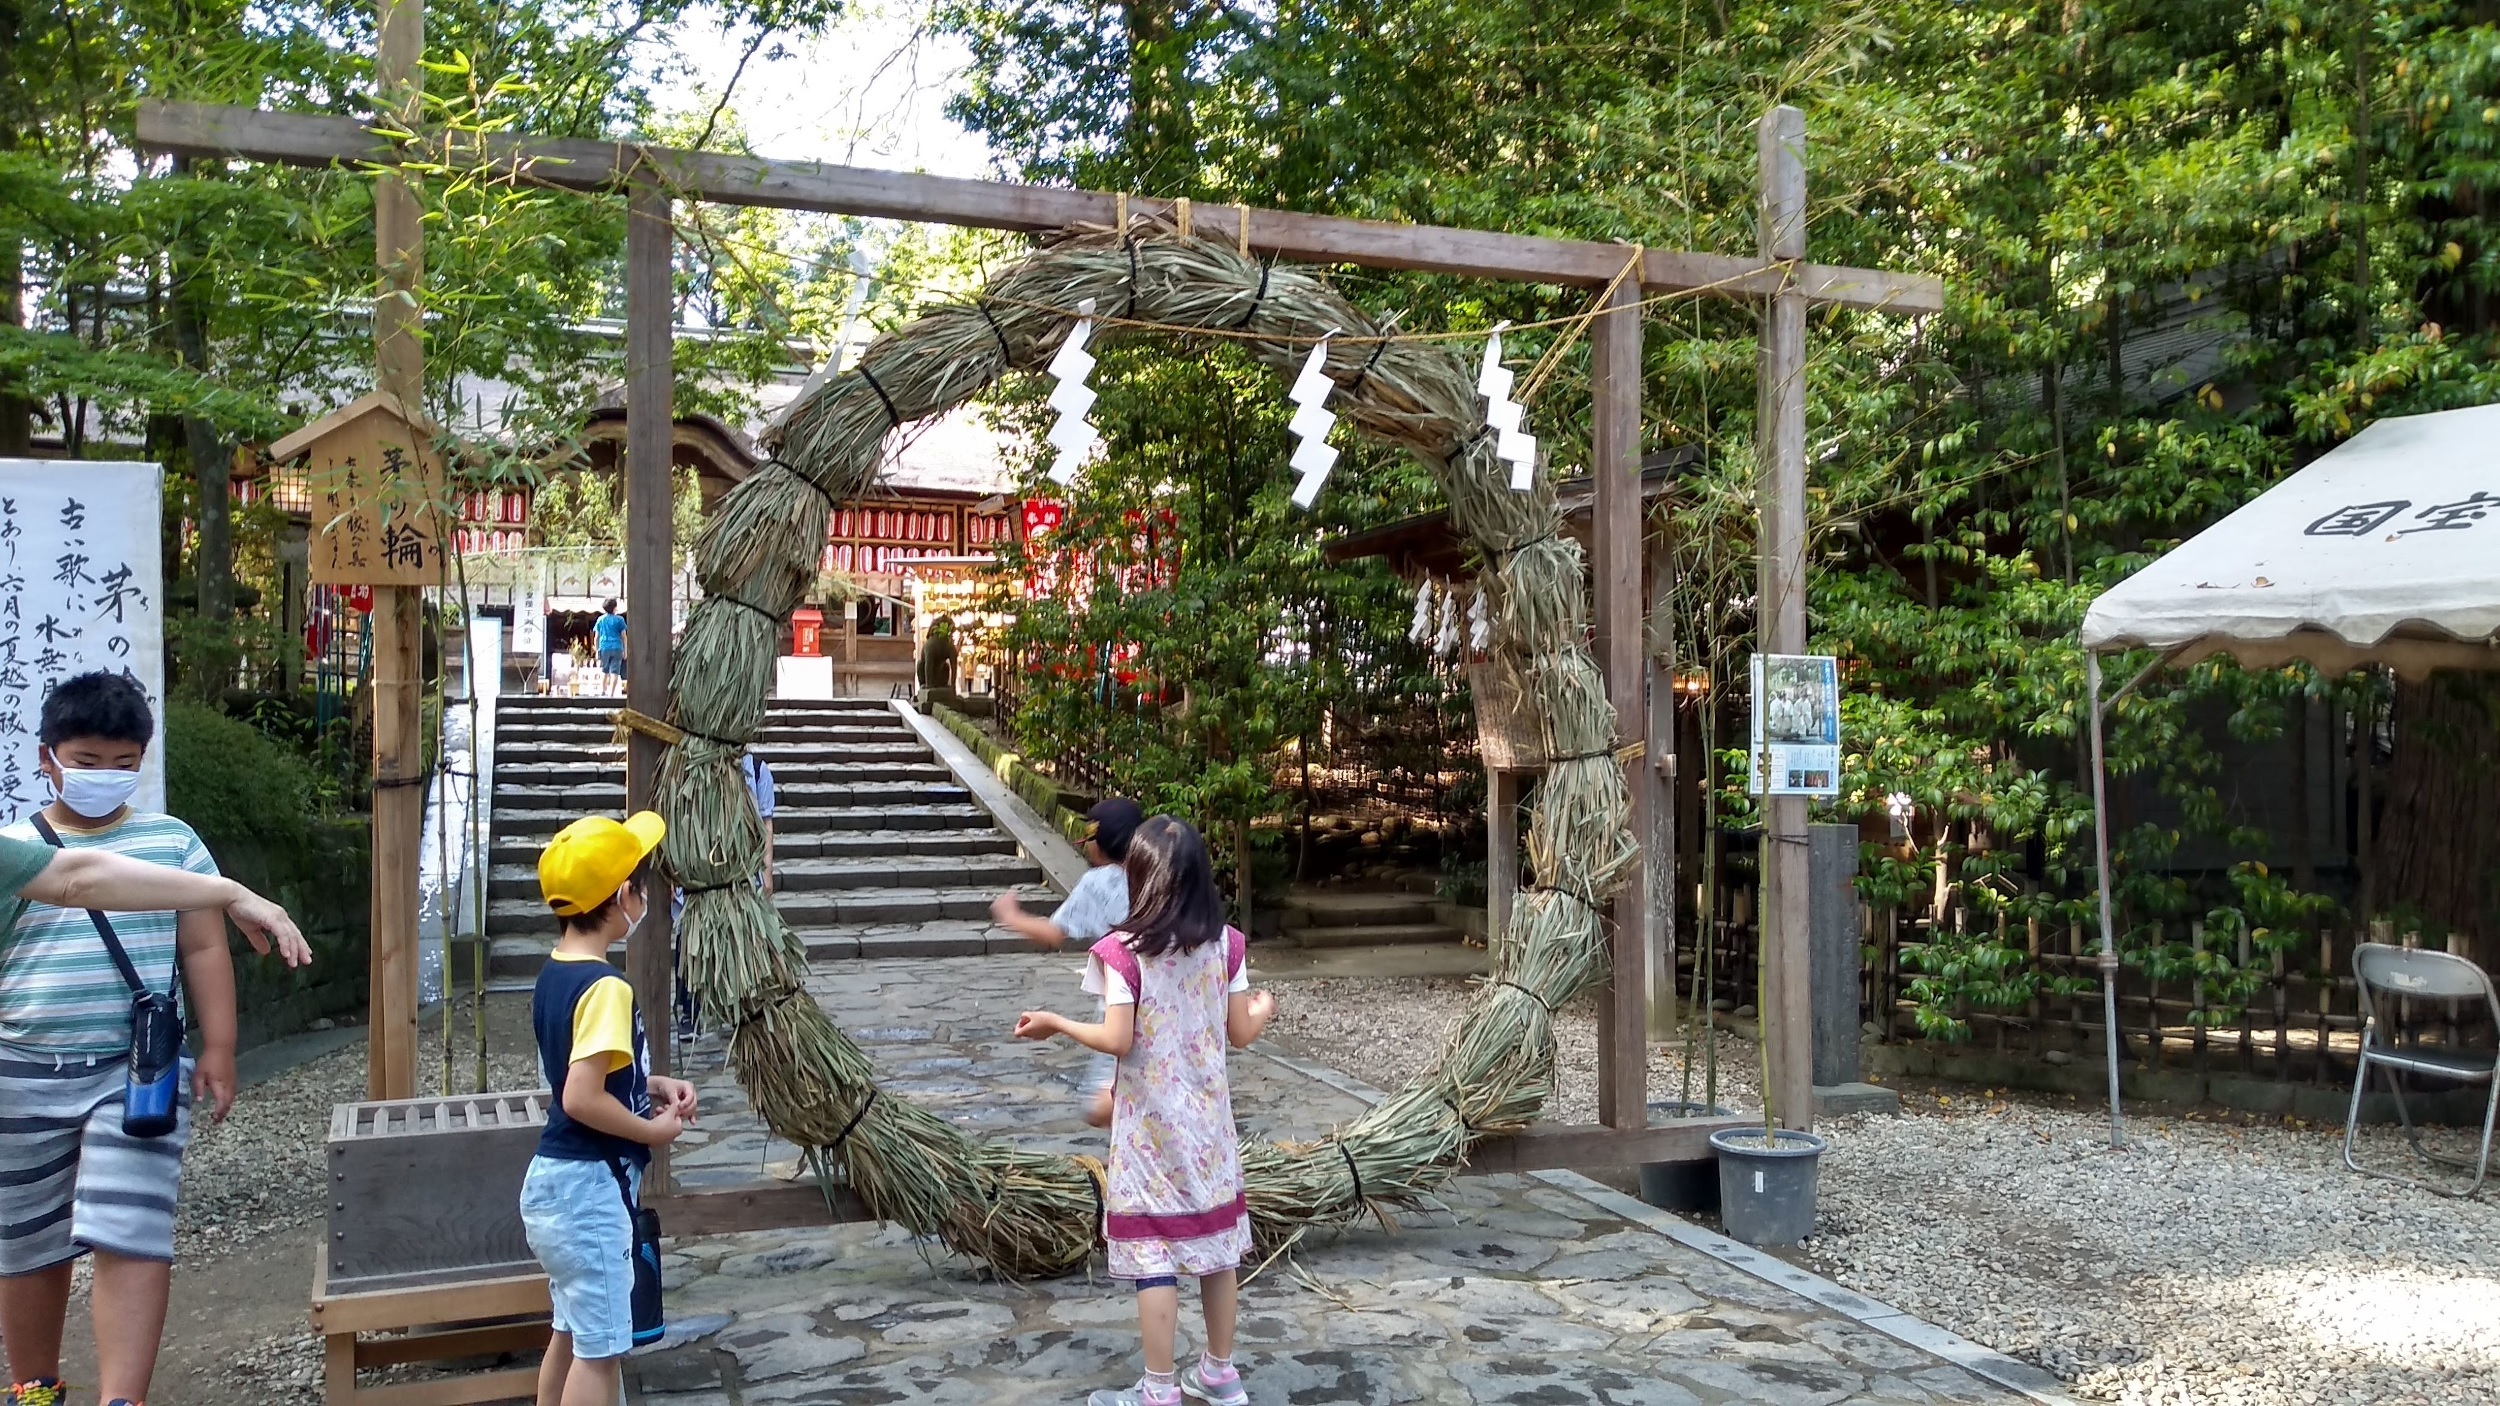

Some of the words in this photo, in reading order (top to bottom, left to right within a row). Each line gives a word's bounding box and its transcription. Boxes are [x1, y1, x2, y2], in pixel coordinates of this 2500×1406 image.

[2304, 491, 2500, 536] 国宝
[53, 497, 96, 611] 古い歌に
